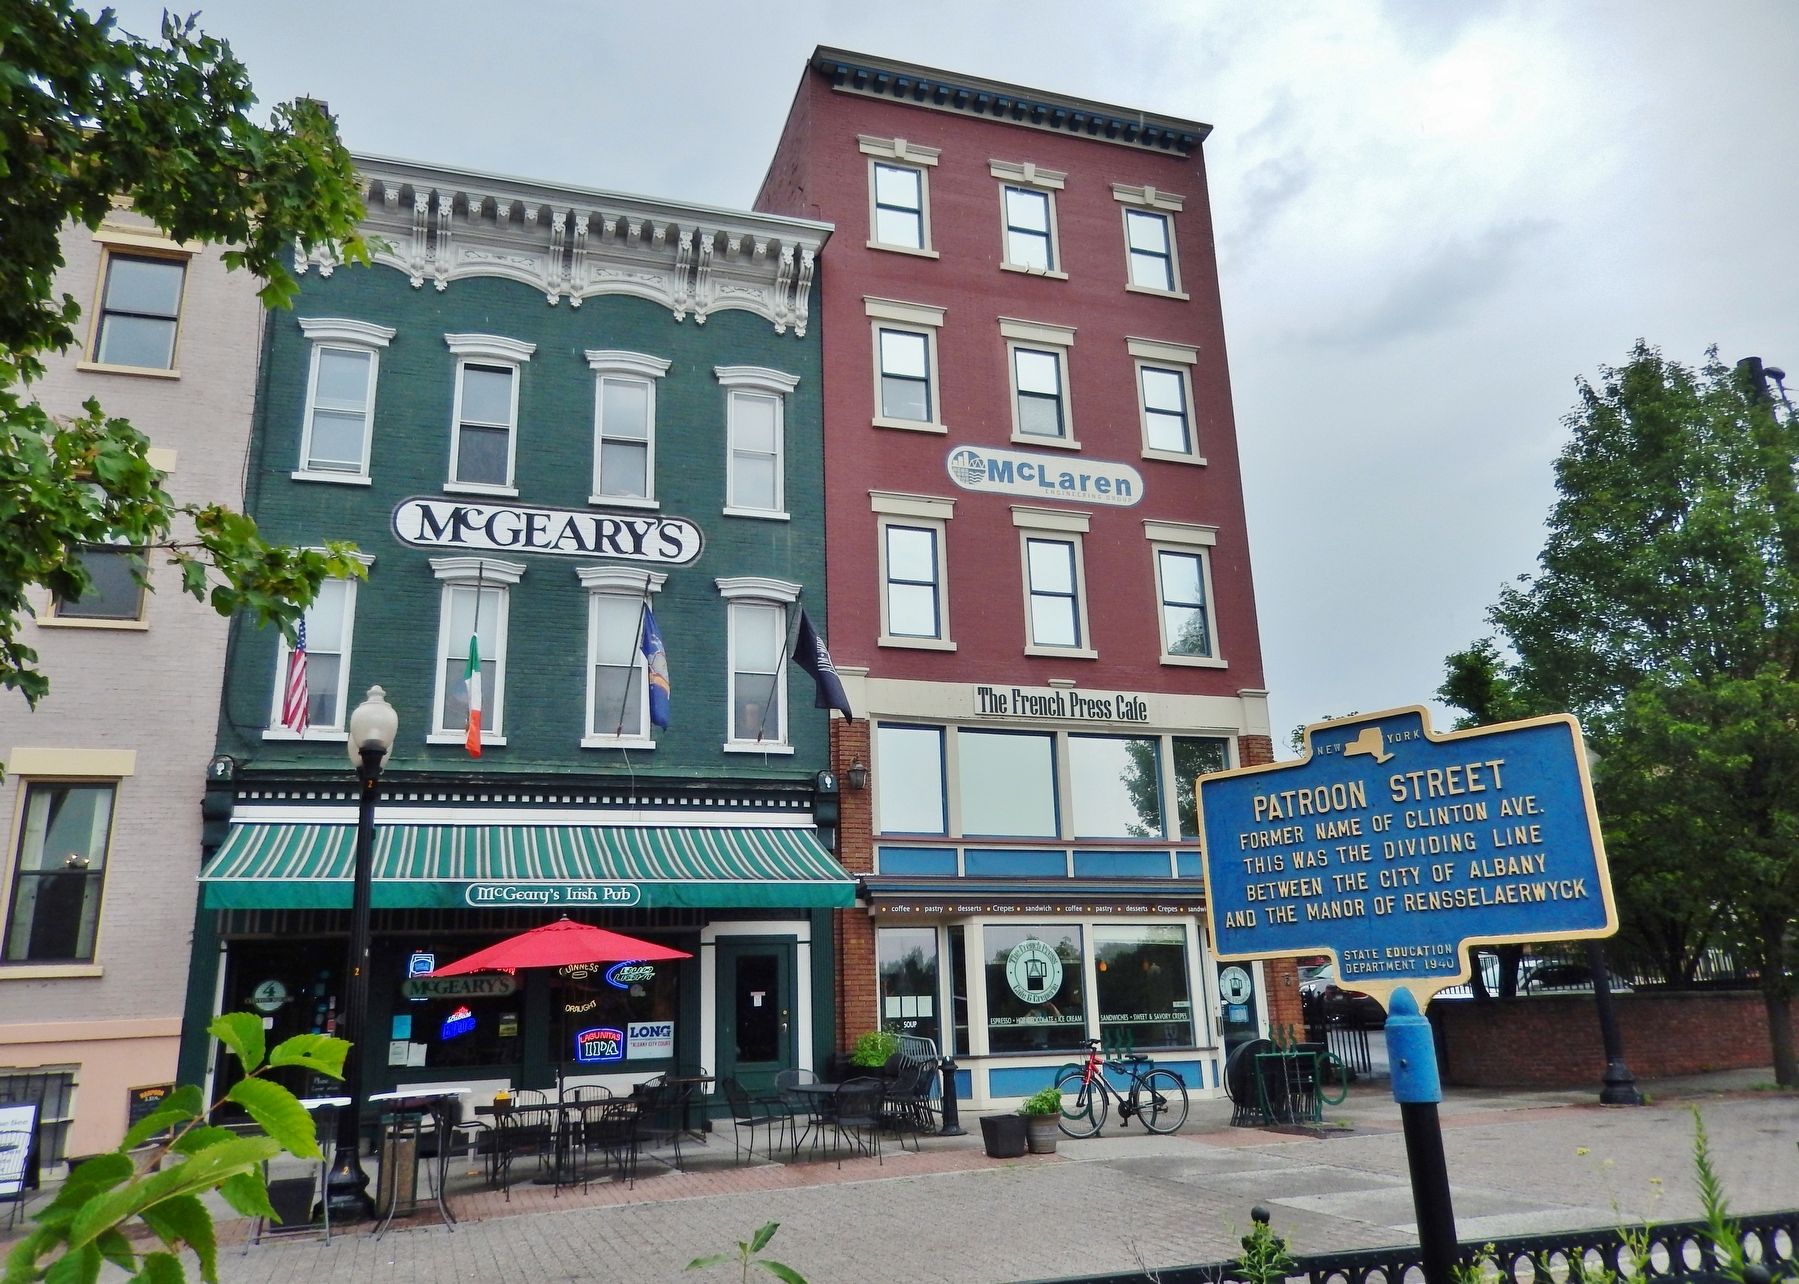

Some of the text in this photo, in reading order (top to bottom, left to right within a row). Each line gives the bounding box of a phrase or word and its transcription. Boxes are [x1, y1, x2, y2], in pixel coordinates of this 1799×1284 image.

[986, 458, 1132, 496] McLaren
[413, 504, 683, 558] McGEARY'S
[977, 687, 1147, 721] The French Press Cafe
[1317, 729, 1420, 756] NEW YORK
[1253, 759, 1505, 822] PATROON STREET
[1240, 795, 1545, 850] FORMER NAME OF CLINTON AVE.
[1243, 825, 1543, 874] THIS WAS THE DIVIDING LINE
[1246, 853, 1546, 901] BETWEEN THE CITY OF ALBANY
[476, 887, 631, 905] McGeary's Irish Pub
[1225, 878, 1589, 928] AND THE MANOR OF RENSSELAERWYCK
[924, 905, 944, 913] pastry
[992, 905, 1015, 913] Crepes
[1095, 905, 1113, 913] pastry
[1157, 905, 1178, 913] Crepes
[1344, 944, 1452, 960] STATE EDUCATION
[1346, 958, 1454, 974] DEPARTMENT 1940
[263, 982, 276, 997] 4
[565, 1000, 598, 1013] DRAUGHT
[990, 1017, 1012, 1025] ESPRESSO
[1100, 1013, 1129, 1021] SANDWICHES
[580, 1031, 621, 1043] LAGUNITAS
[630, 1025, 671, 1038] LONG
[585, 1040, 619, 1057] IPA
